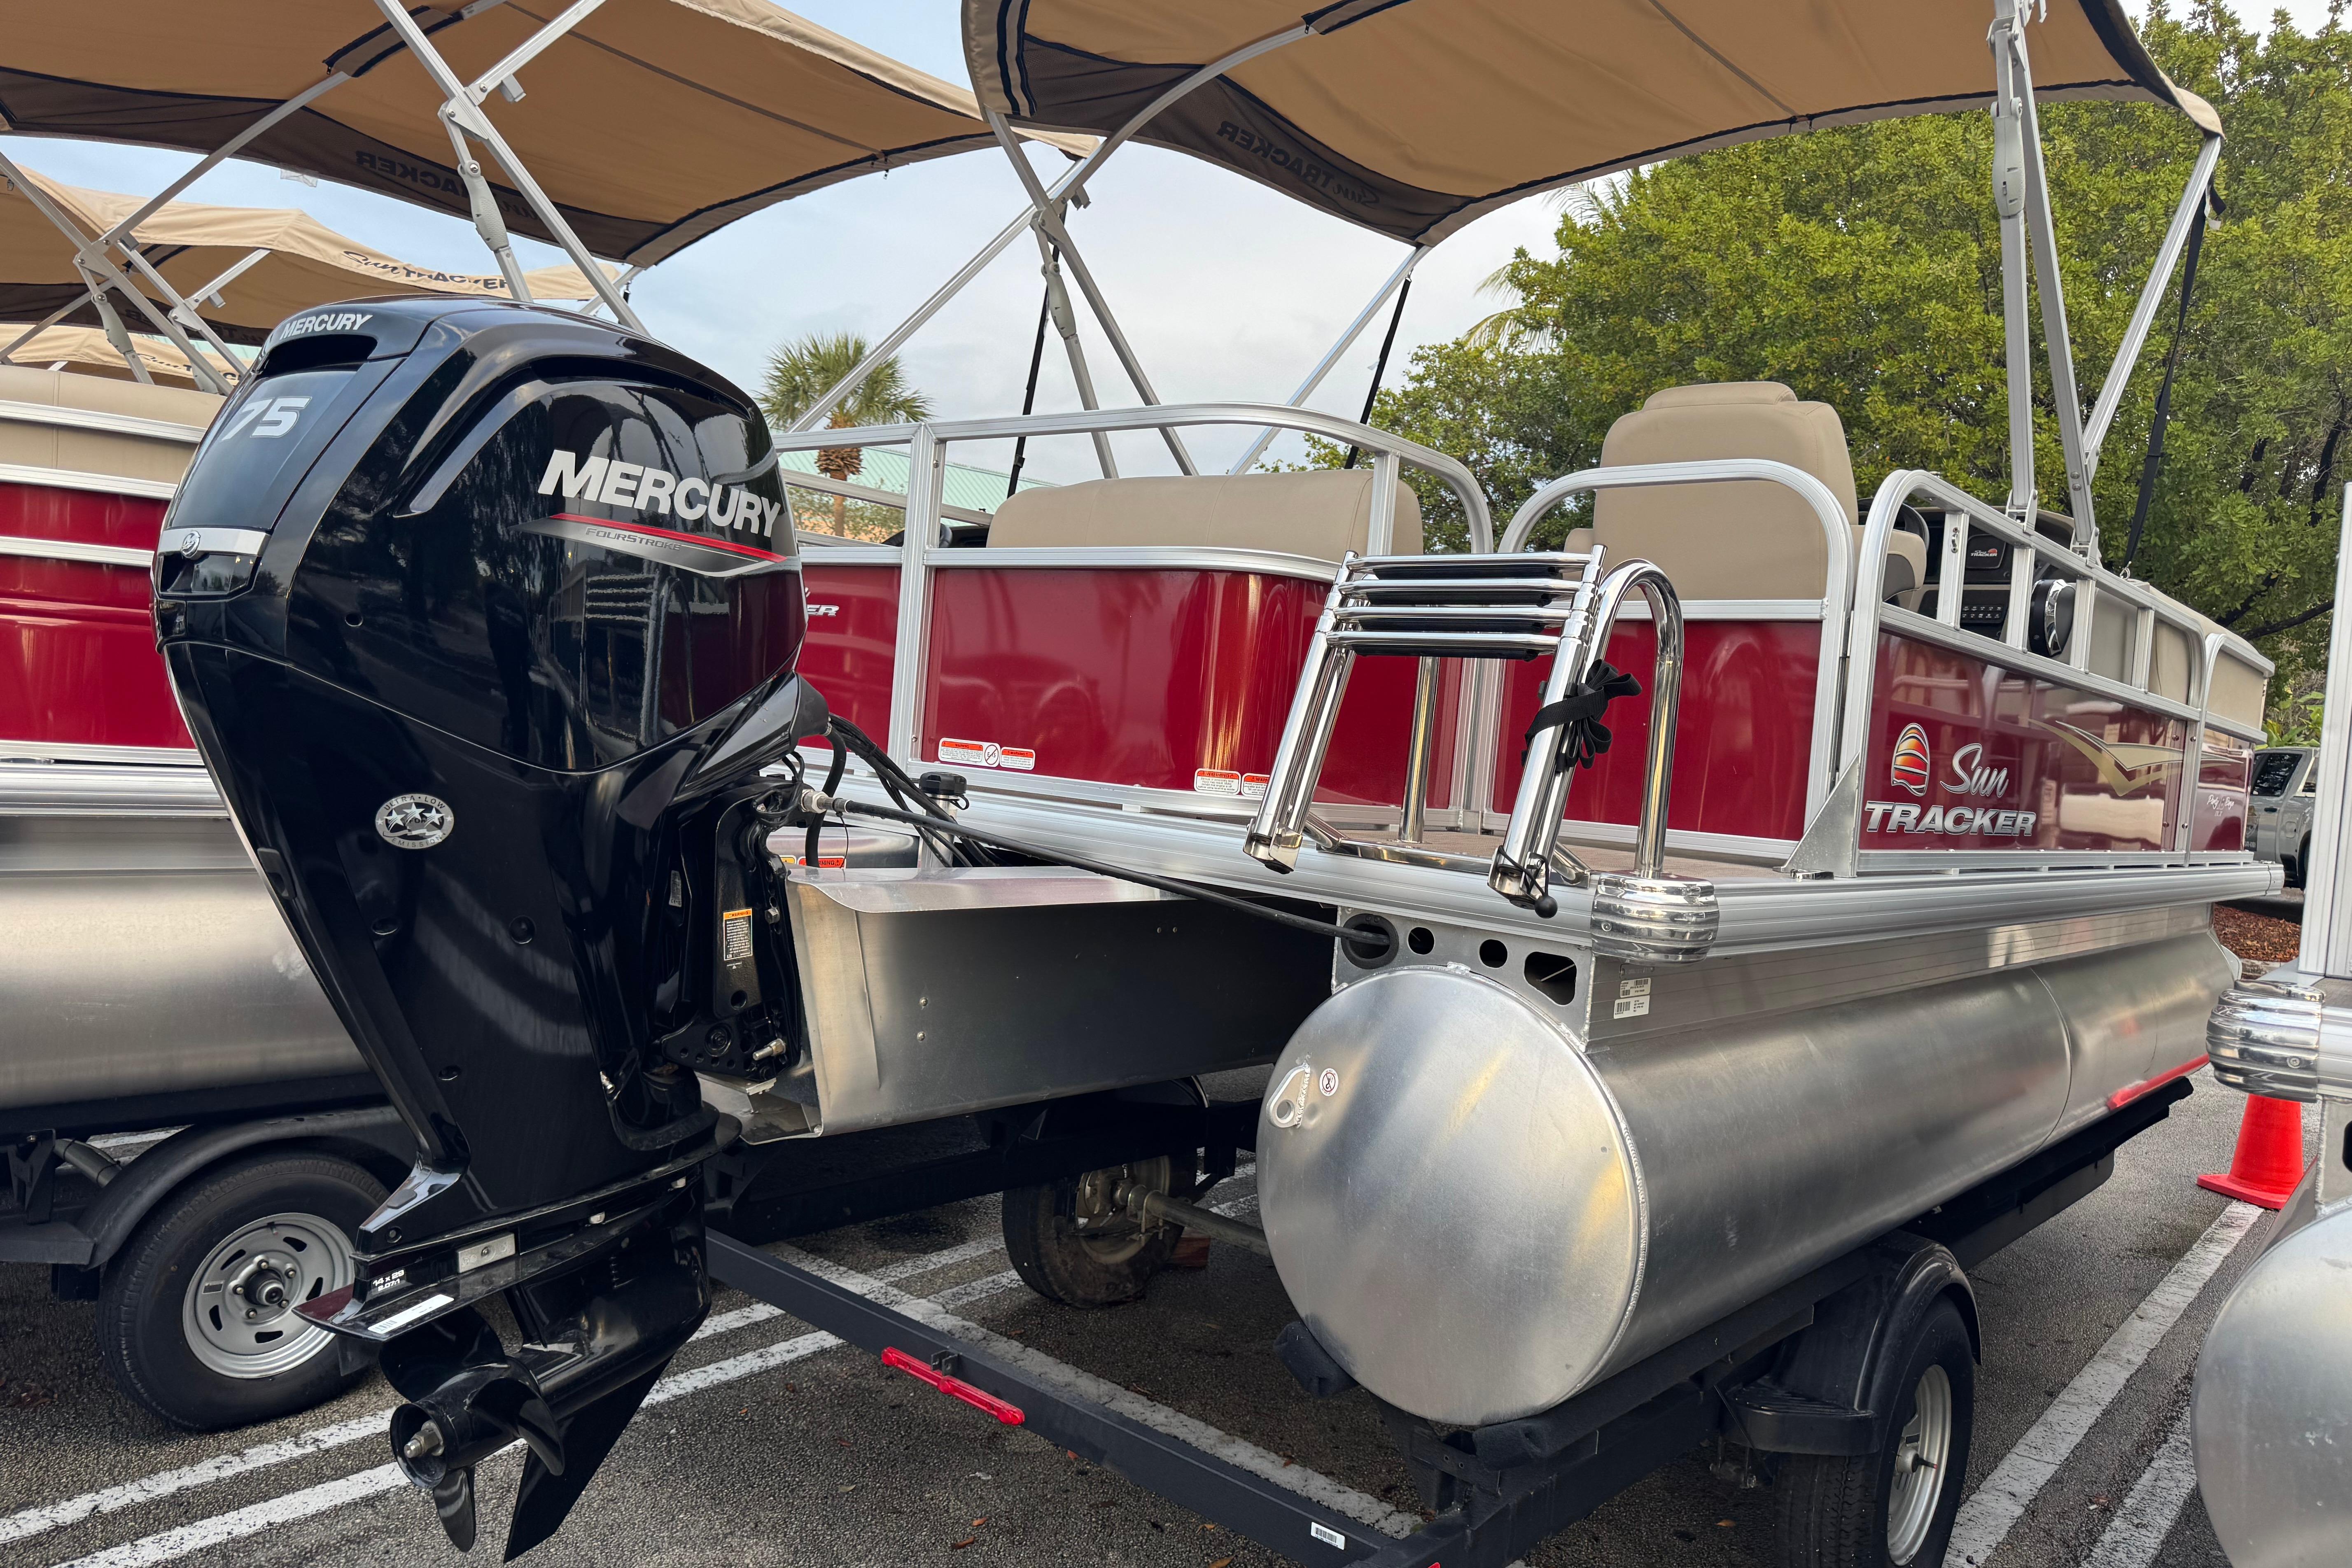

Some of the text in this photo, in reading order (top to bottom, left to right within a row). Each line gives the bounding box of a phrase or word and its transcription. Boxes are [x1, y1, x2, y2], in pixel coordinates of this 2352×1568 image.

[343, 250, 400, 274] Sun
[279, 313, 374, 340] MERCURY
[219, 396, 312, 442] 75
[537, 449, 781, 537] MERCURY
[1939, 743, 2009, 798] Sun
[384, 795, 446, 811] ULTRA LOW
[1864, 800, 2037, 837] TRACKER
[391, 834, 443, 848] EMISSION
[373, 1277, 385, 1286] 14
